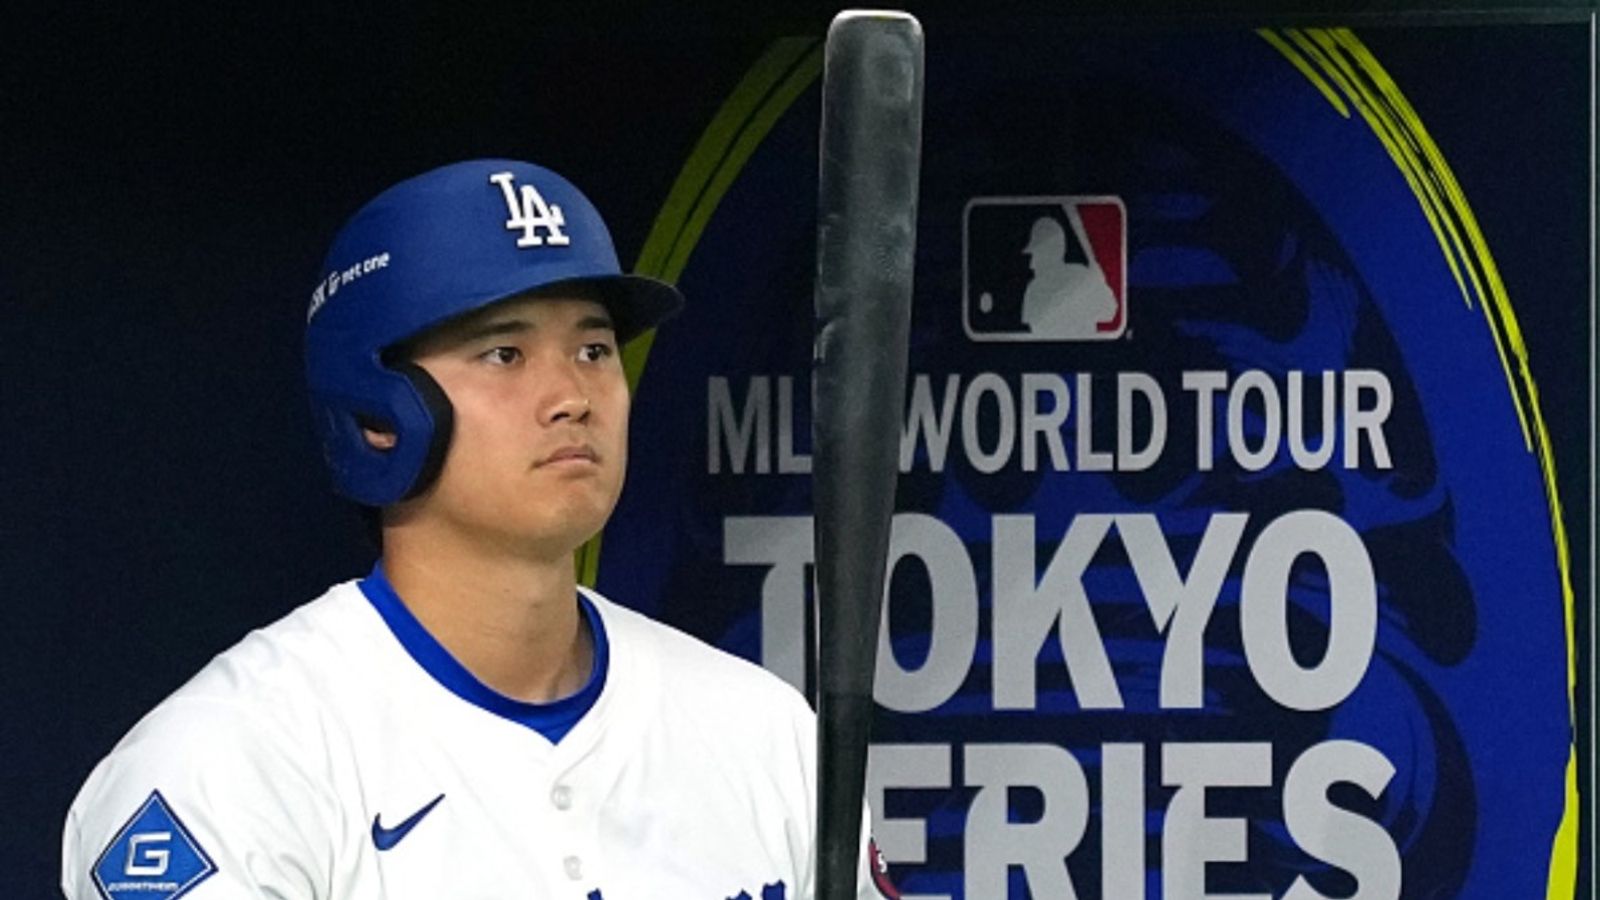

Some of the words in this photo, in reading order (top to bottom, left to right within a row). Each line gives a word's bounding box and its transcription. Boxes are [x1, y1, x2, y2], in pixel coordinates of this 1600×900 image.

[490, 171, 570, 247] LA
[363, 252, 390, 273] one
[707, 374, 815, 475] ML
[899, 371, 1168, 475] WORLD
[1182, 368, 1394, 471] TOUR
[723, 508, 1379, 714] TOKYO
[125, 831, 172, 876] G
[864, 738, 1402, 900] ERIES
